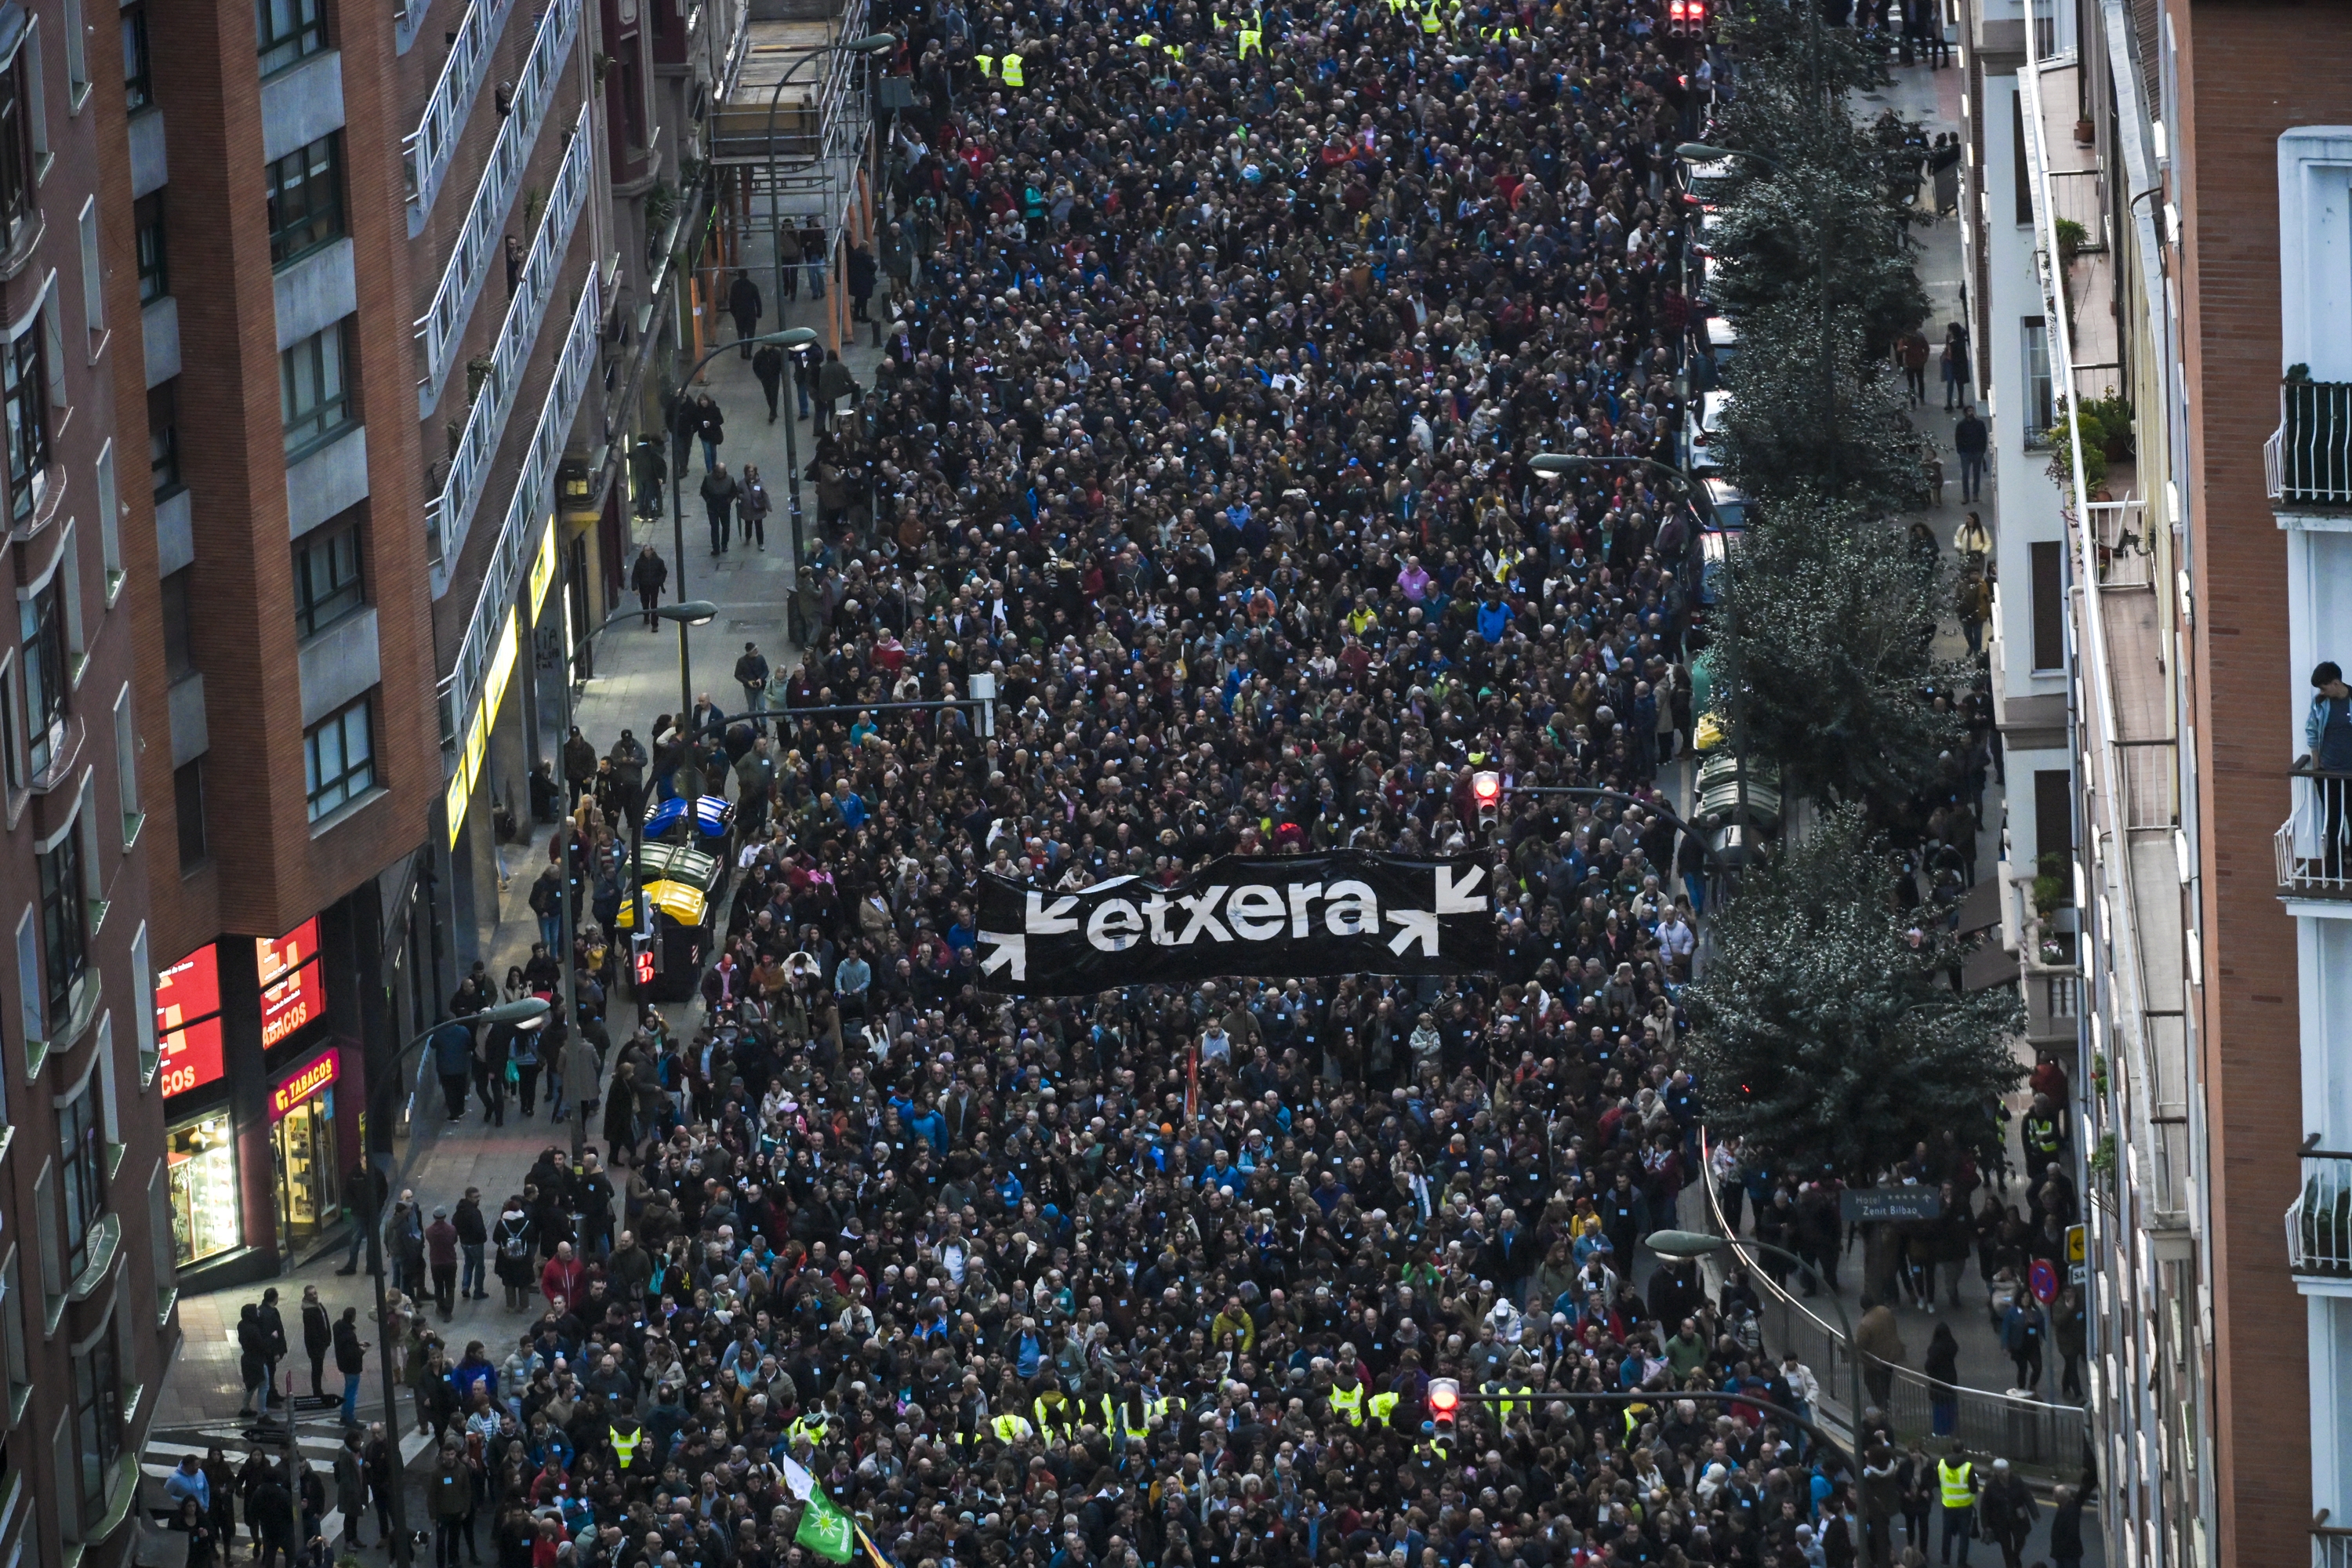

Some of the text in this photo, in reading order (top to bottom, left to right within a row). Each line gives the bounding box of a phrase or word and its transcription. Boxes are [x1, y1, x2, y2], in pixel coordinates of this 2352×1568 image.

[1087, 880, 1378, 952] etxera
[263, 1001, 307, 1048] ABACOS
[162, 1065, 195, 1097] COS
[289, 1058, 332, 1098] TABACOS
[1855, 1196, 1881, 1205] Hotel
[1863, 1205, 1918, 1216] Zenit Bilbao
[2074, 1271, 2085, 1279] SA
